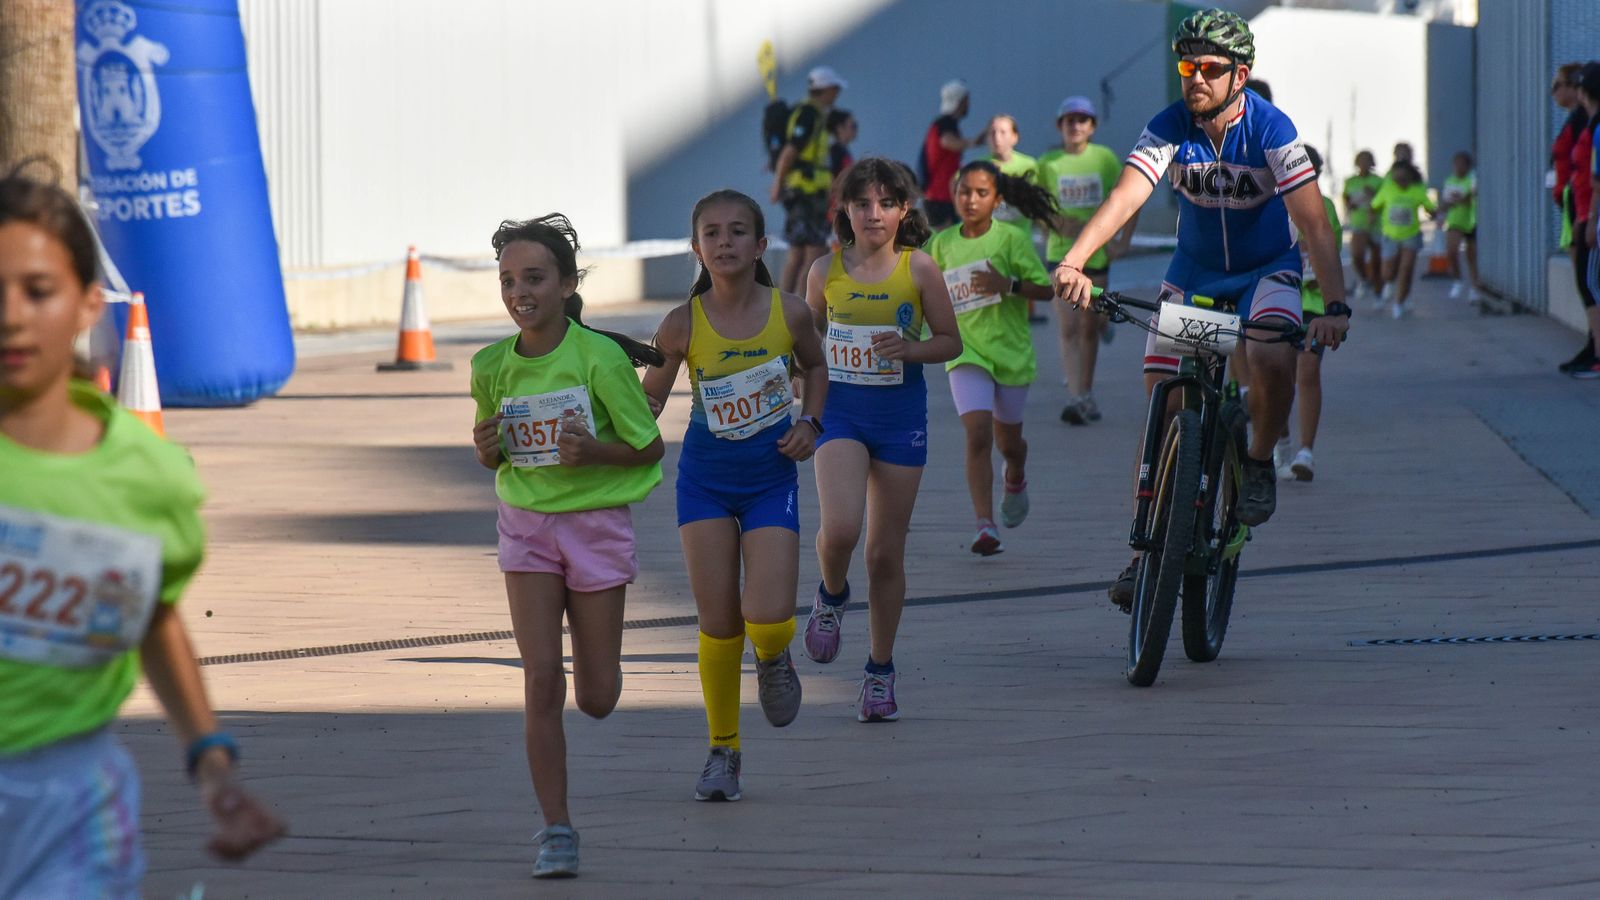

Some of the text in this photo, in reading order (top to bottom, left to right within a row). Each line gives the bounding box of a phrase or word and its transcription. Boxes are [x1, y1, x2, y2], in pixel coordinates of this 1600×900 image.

[170, 168, 197, 188] DE
[1180, 165, 1263, 200] UCA
[1176, 317, 1223, 343] XXI
[830, 344, 872, 368] 1181
[538, 393, 576, 405] ALEJANDRA
[703, 386, 718, 397] XXI
[711, 391, 761, 425] 1207
[507, 417, 558, 447] 1357
